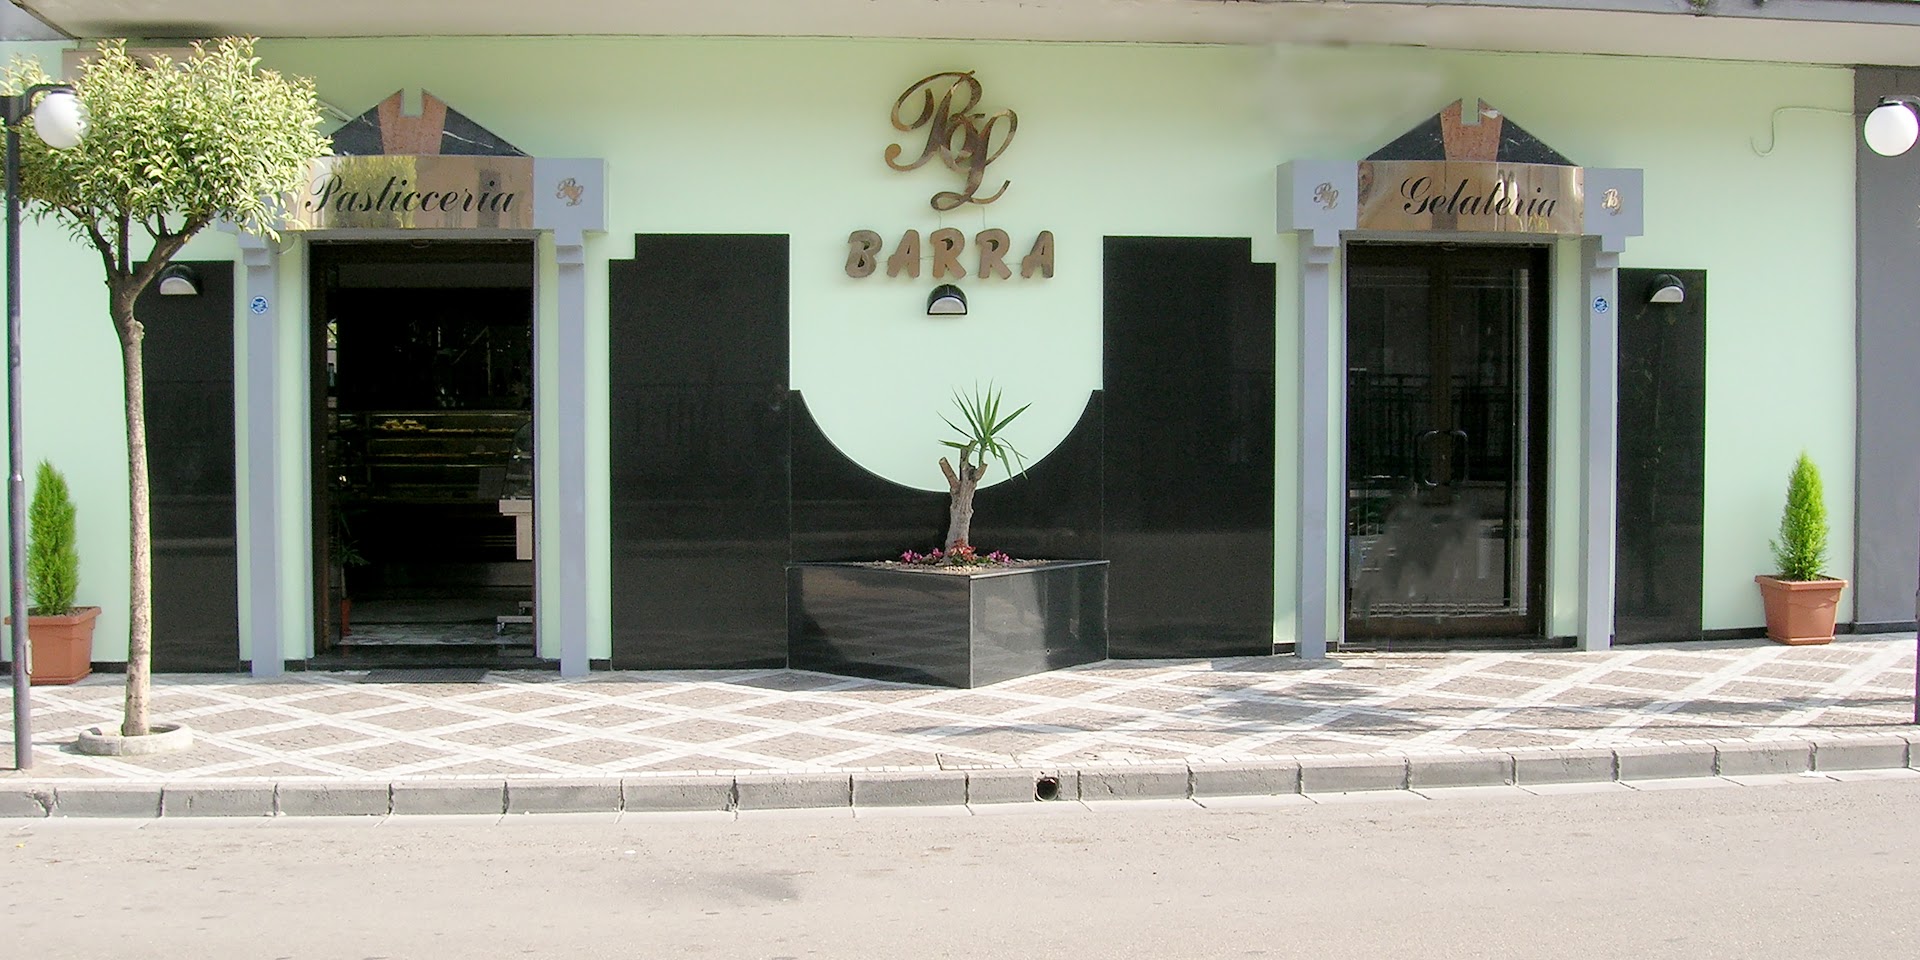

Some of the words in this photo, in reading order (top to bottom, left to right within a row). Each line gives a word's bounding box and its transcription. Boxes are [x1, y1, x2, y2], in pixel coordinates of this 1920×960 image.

[304, 172, 516, 214] Pasticceria
[1400, 175, 1559, 218] Gelateria
[845, 228, 1055, 280] BARRA
